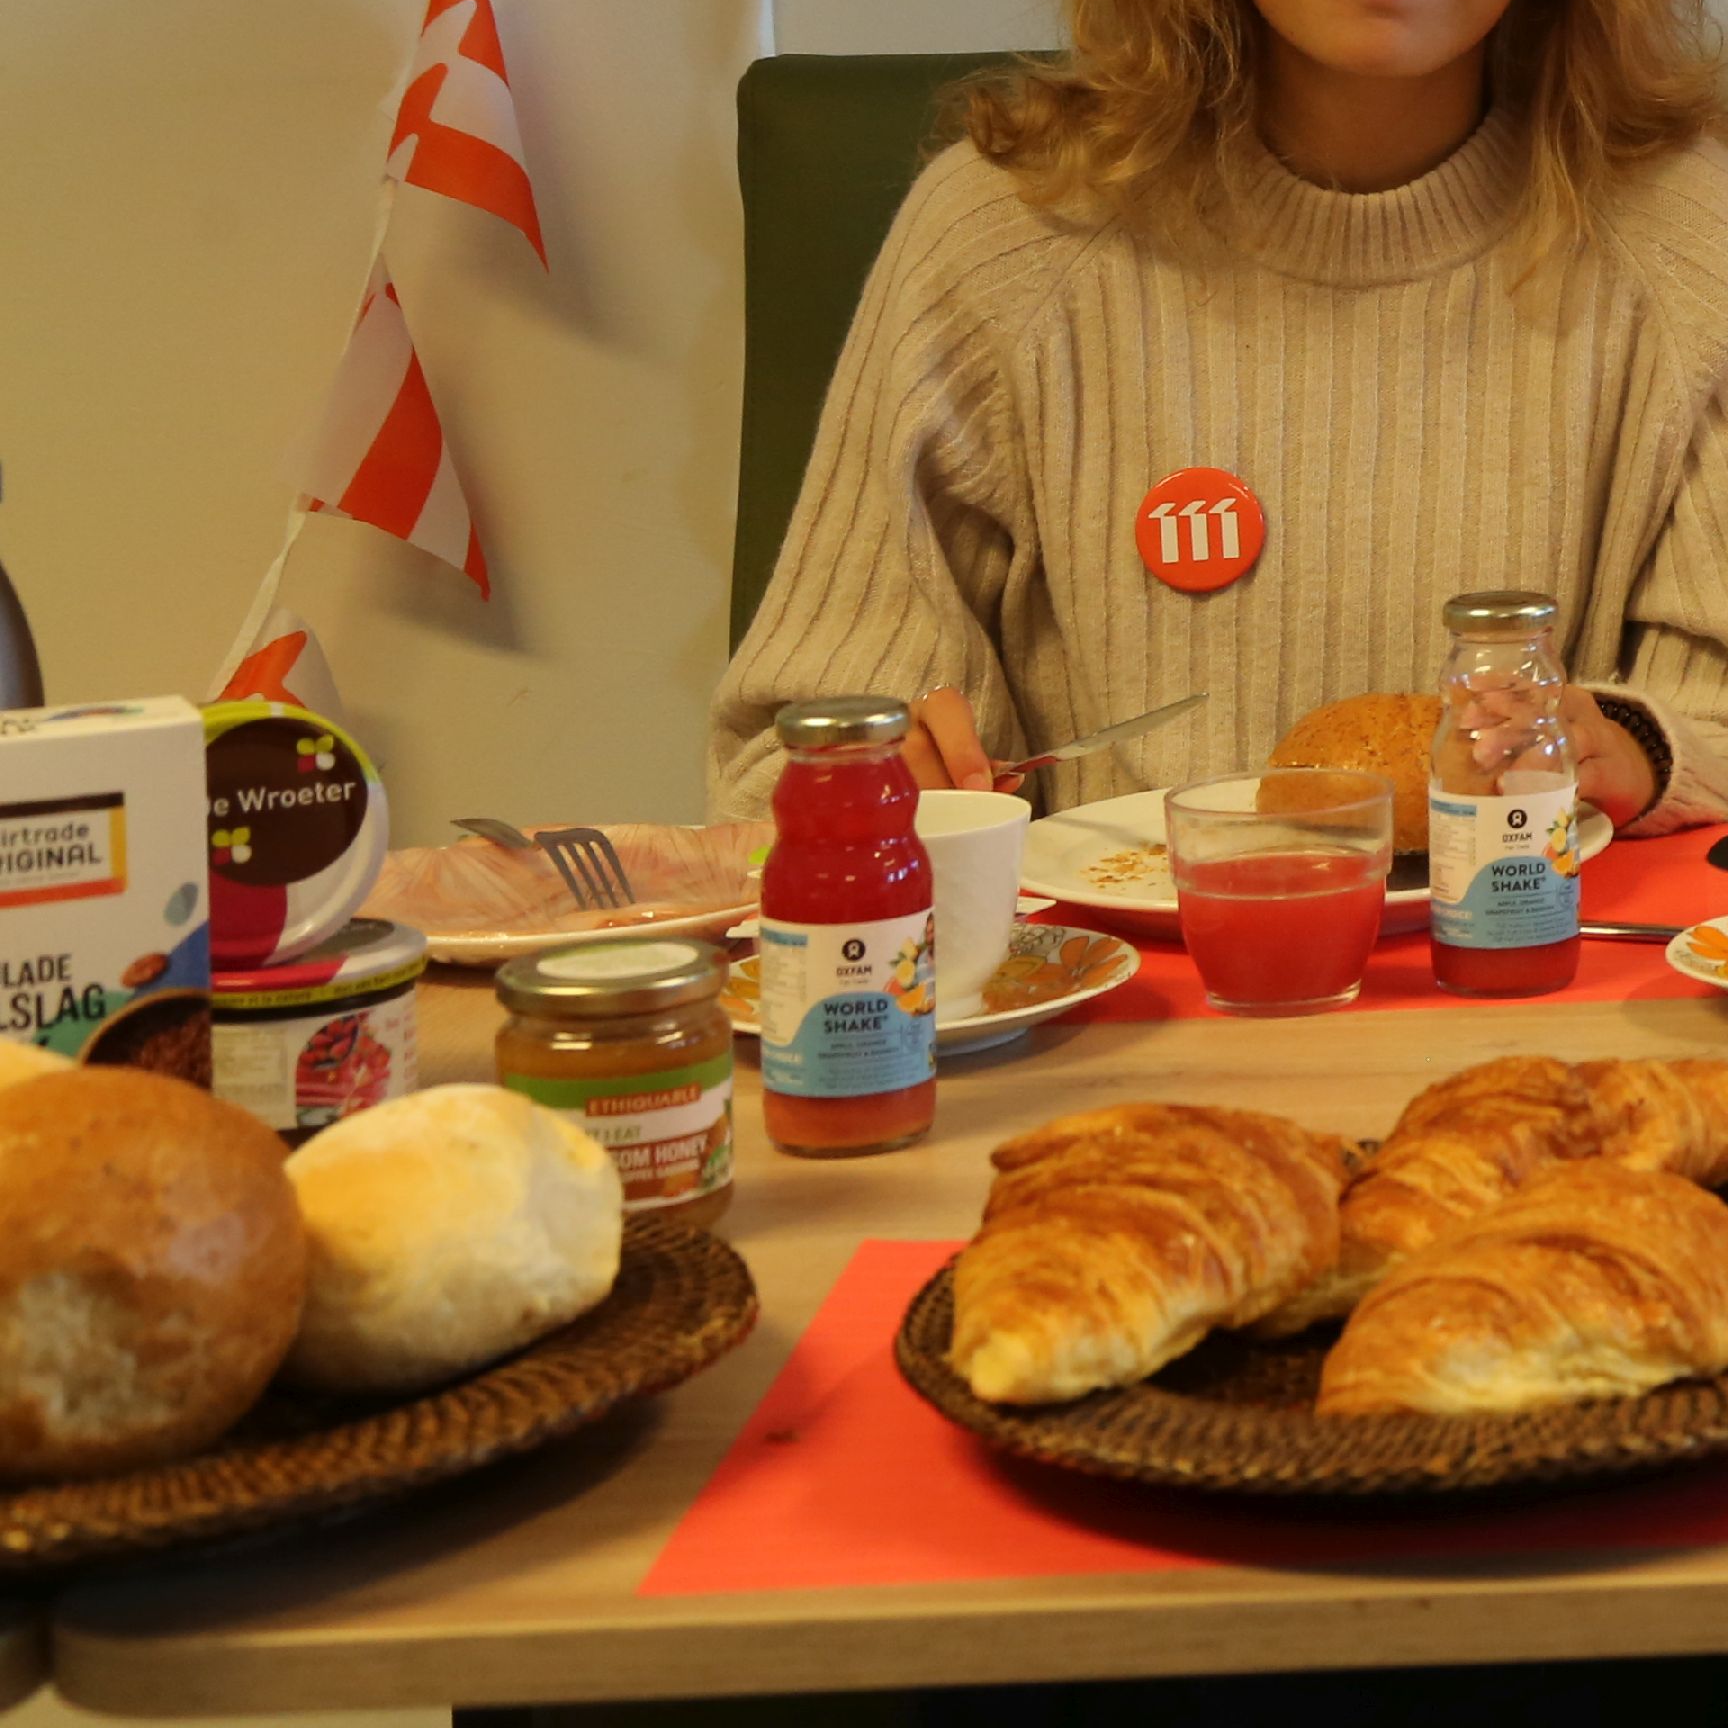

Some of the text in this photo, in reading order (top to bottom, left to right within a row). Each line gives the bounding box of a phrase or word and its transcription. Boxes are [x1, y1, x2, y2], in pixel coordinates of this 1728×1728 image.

[237, 781, 356, 813] Wroeter
[0, 822, 91, 847] irtrade
[1502, 832, 1533, 843] OXFAM
[0, 843, 102, 873] IGINAL
[1491, 863, 1546, 877] WORLD
[0, 953, 72, 988] LADE
[0, 982, 107, 1031] SLAG
[824, 998, 889, 1016] WORLD
[655, 1133, 708, 1165] HONEY
